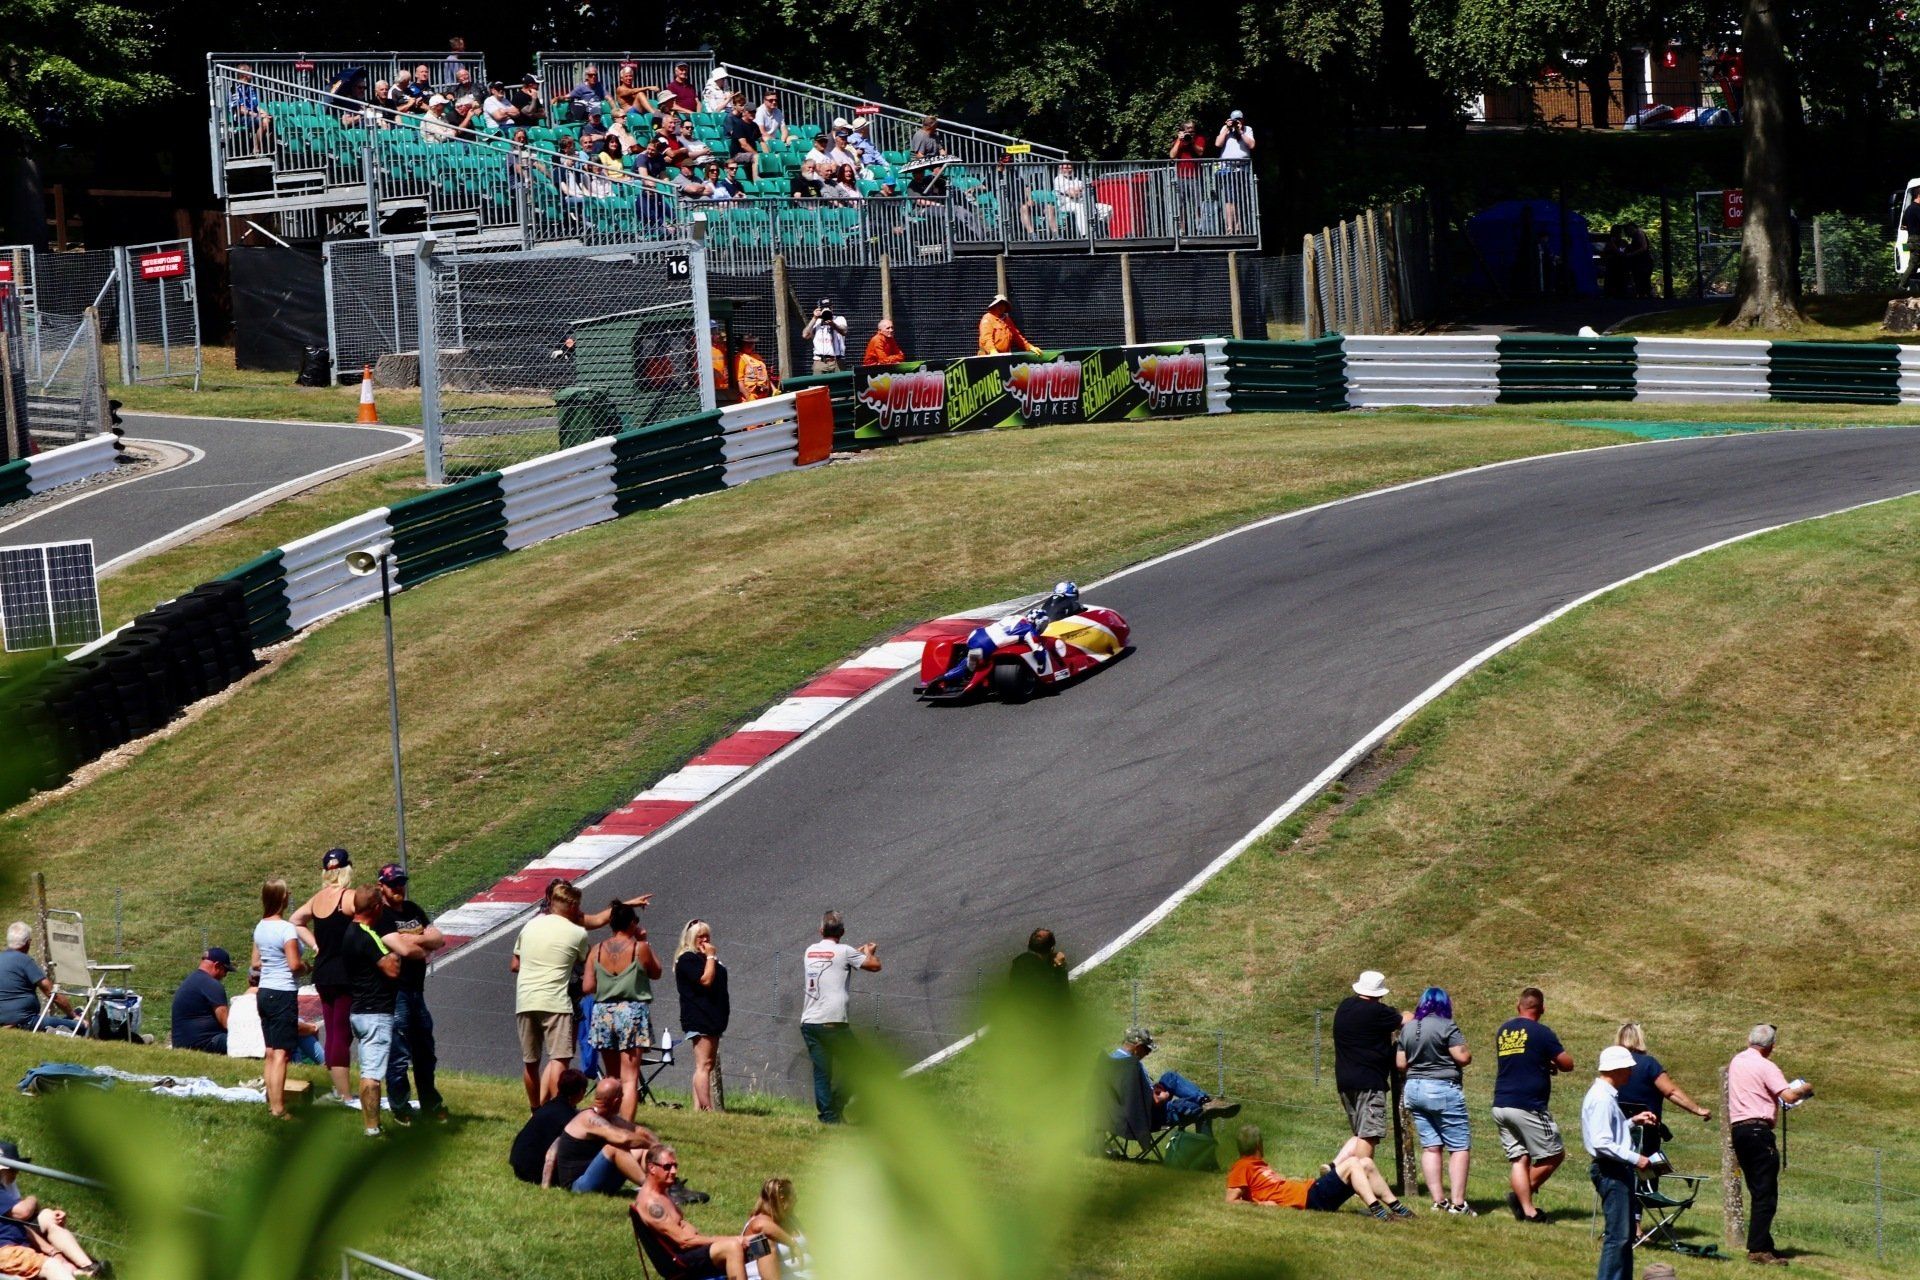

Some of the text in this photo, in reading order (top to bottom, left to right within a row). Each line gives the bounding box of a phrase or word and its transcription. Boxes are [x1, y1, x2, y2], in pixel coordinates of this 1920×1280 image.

[670, 260, 688, 274] 16
[945, 362, 969, 399] ECU
[1082, 353, 1103, 390] ECU
[946, 368, 1002, 428] REMAPPING
[1081, 360, 1131, 418] REMAPPING
[1160, 392, 1201, 408] BIKES
[894, 411, 941, 428] BIKES
[1034, 401, 1077, 417] BIKES
